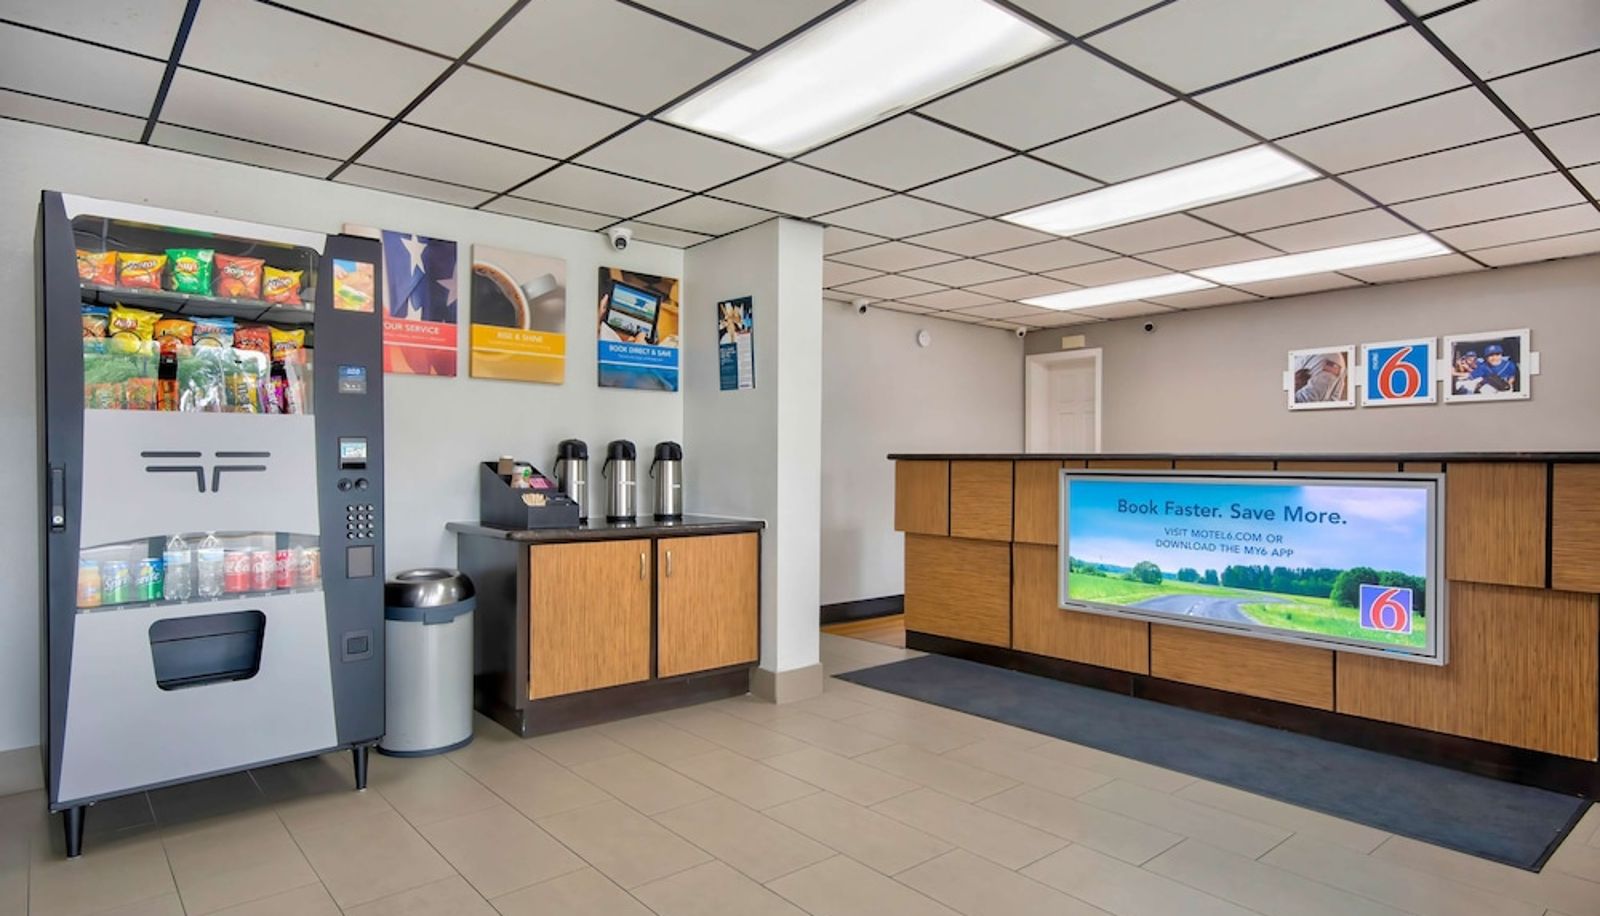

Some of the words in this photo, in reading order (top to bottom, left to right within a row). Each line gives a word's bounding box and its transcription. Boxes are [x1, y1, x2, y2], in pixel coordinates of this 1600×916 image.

[405, 325, 440, 335] SERVICE
[497, 332, 513, 340] RISE
[522, 335, 543, 343] SHINE
[609, 345, 628, 353] BOOK
[629, 347, 651, 356] DIRECT
[1377, 346, 1421, 400] 6
[1117, 498, 1159, 515] Book
[1165, 501, 1222, 518] Faster.
[1230, 503, 1276, 520] Save
[1284, 505, 1347, 525] More.
[1164, 527, 1188, 537] VISIT
[1191, 529, 1262, 542] MOTEL6.COM
[1266, 533, 1283, 543] OR
[1155, 539, 1216, 552] DOWNLOAD
[1220, 544, 1240, 554] THE
[1244, 545, 1268, 556] MY6
[1271, 548, 1294, 557] APP
[1370, 587, 1408, 631] 6
